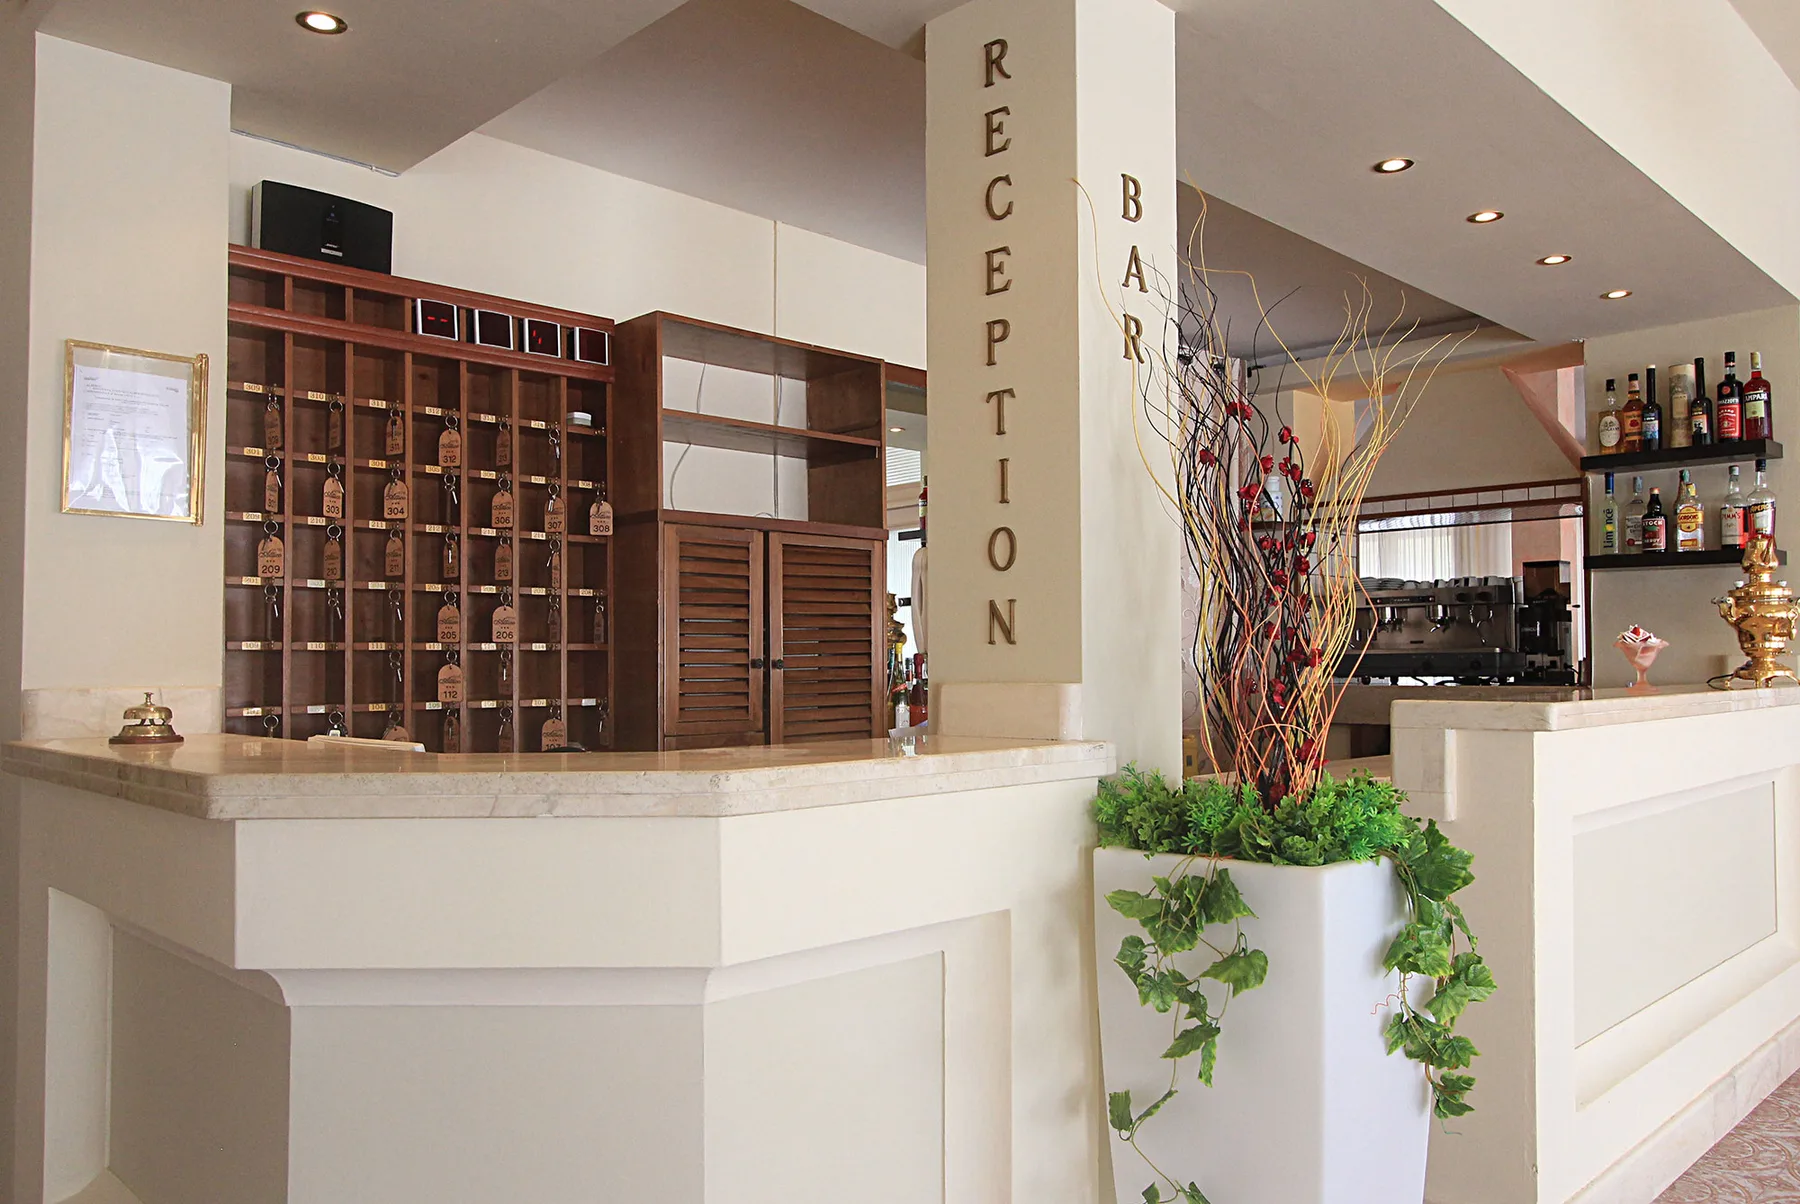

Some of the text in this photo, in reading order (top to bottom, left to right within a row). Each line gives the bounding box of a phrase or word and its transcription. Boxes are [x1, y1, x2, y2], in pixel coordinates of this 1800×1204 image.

[1121, 173, 1149, 364] BAR
[984, 38, 1017, 645] RECEPTION
[1745, 392, 1768, 401] AMPARI
[444, 455, 456, 463] 312
[326, 505, 340, 514] 303
[387, 507, 404, 515] 304
[495, 516, 510, 524] 306
[548, 521, 562, 529] 307
[593, 525, 610, 533] 308
[262, 565, 281, 574] 209
[498, 569, 509, 577] 213
[441, 631, 457, 640] 205
[496, 631, 514, 640] 206
[443, 690, 457, 699] 112
